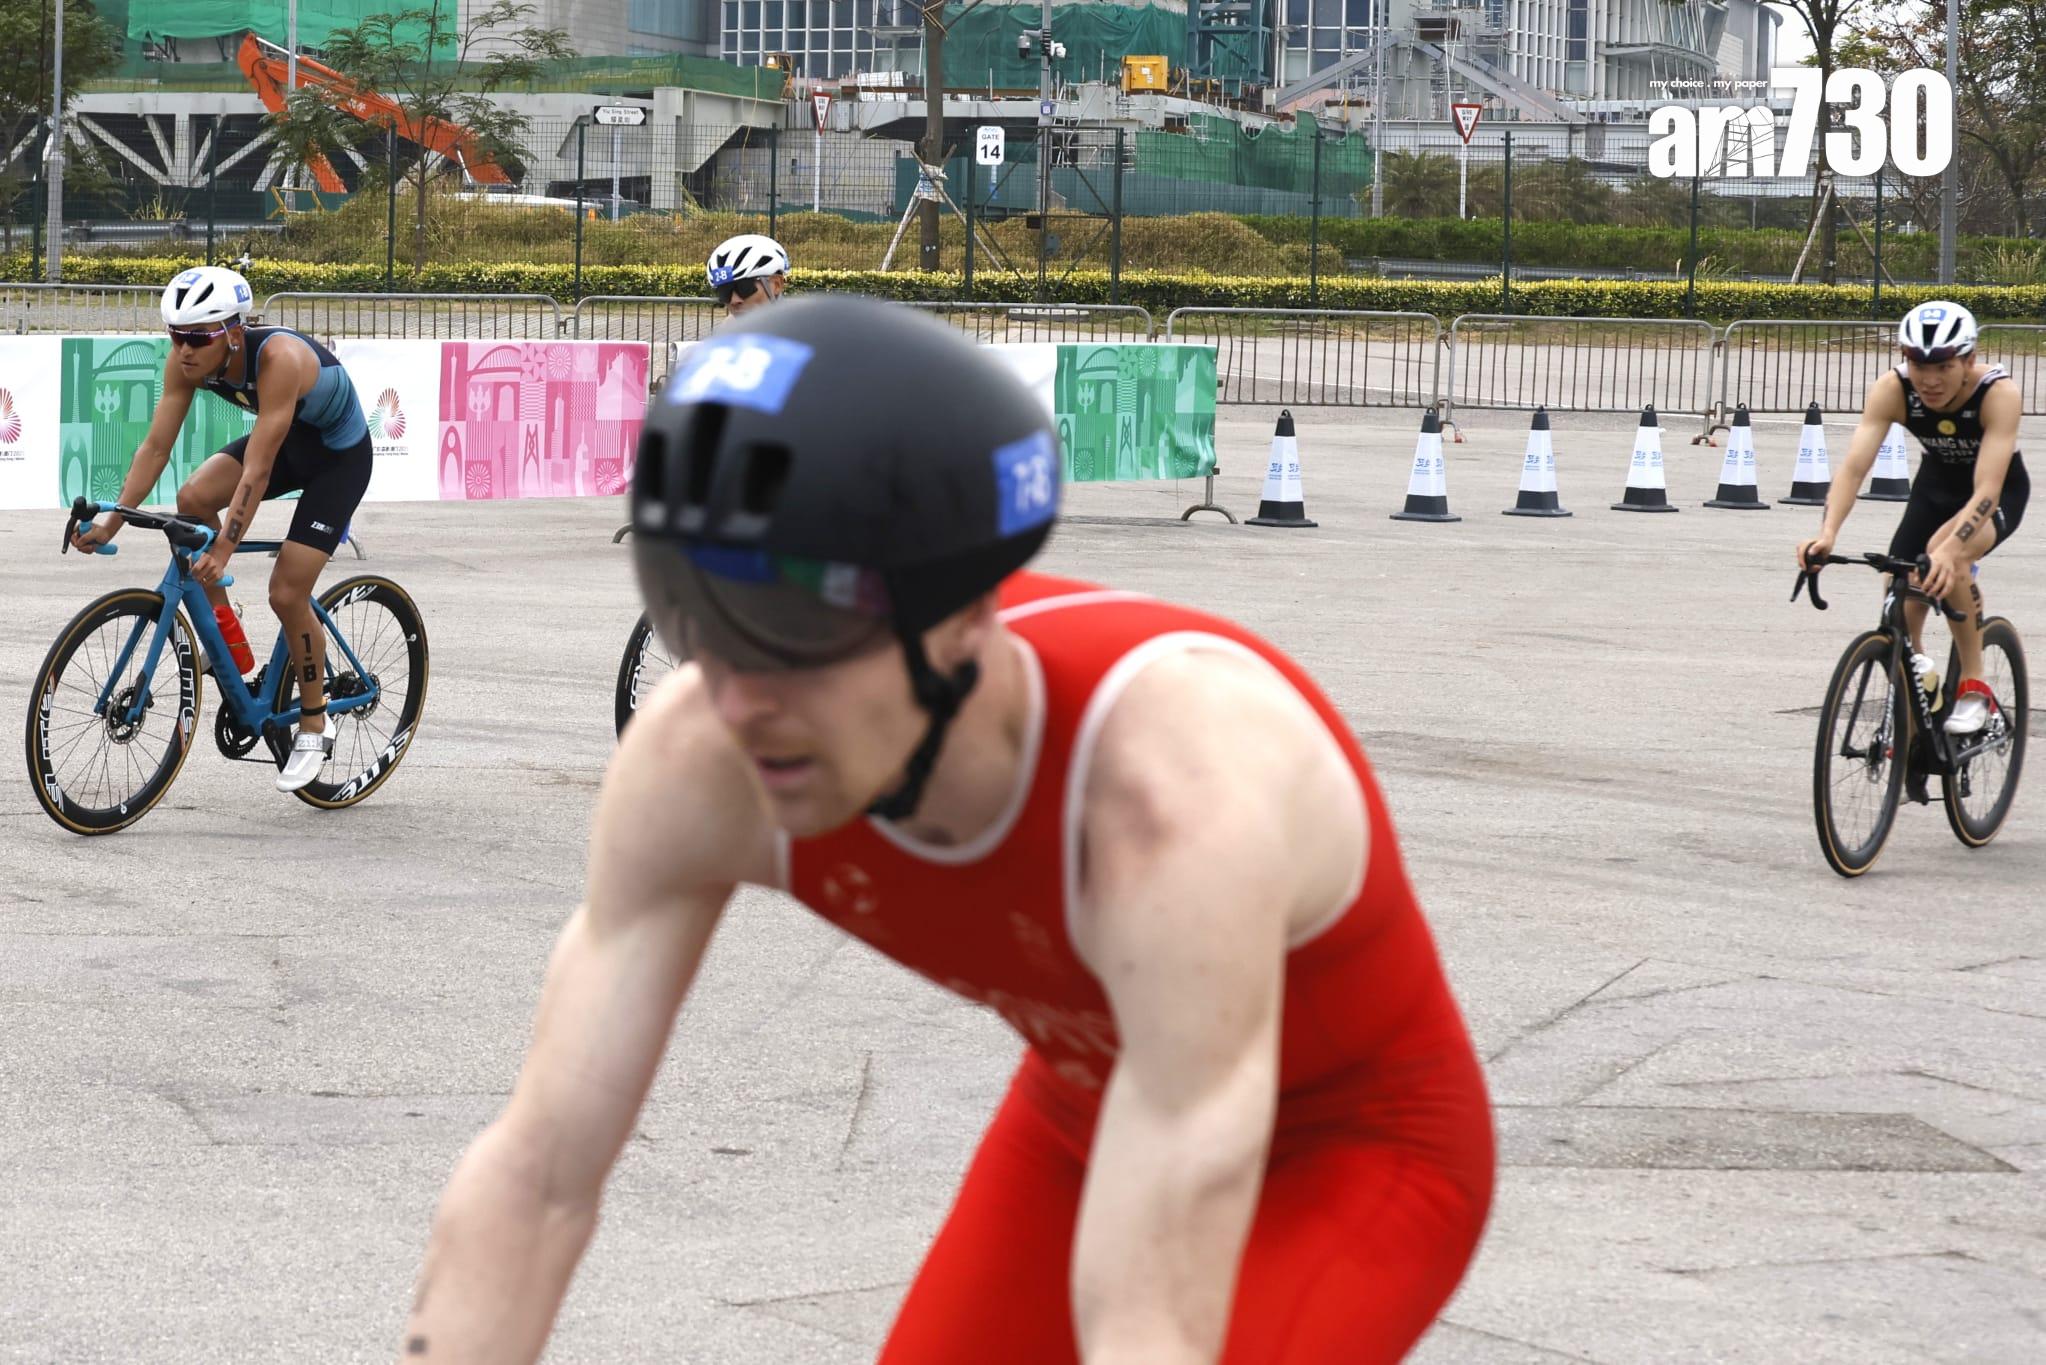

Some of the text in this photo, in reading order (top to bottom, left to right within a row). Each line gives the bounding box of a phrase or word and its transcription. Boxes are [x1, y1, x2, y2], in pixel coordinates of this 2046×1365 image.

[980, 144, 1001, 159] 14
[301, 632, 317, 683] 1-B
[330, 723, 411, 802] ELITE
